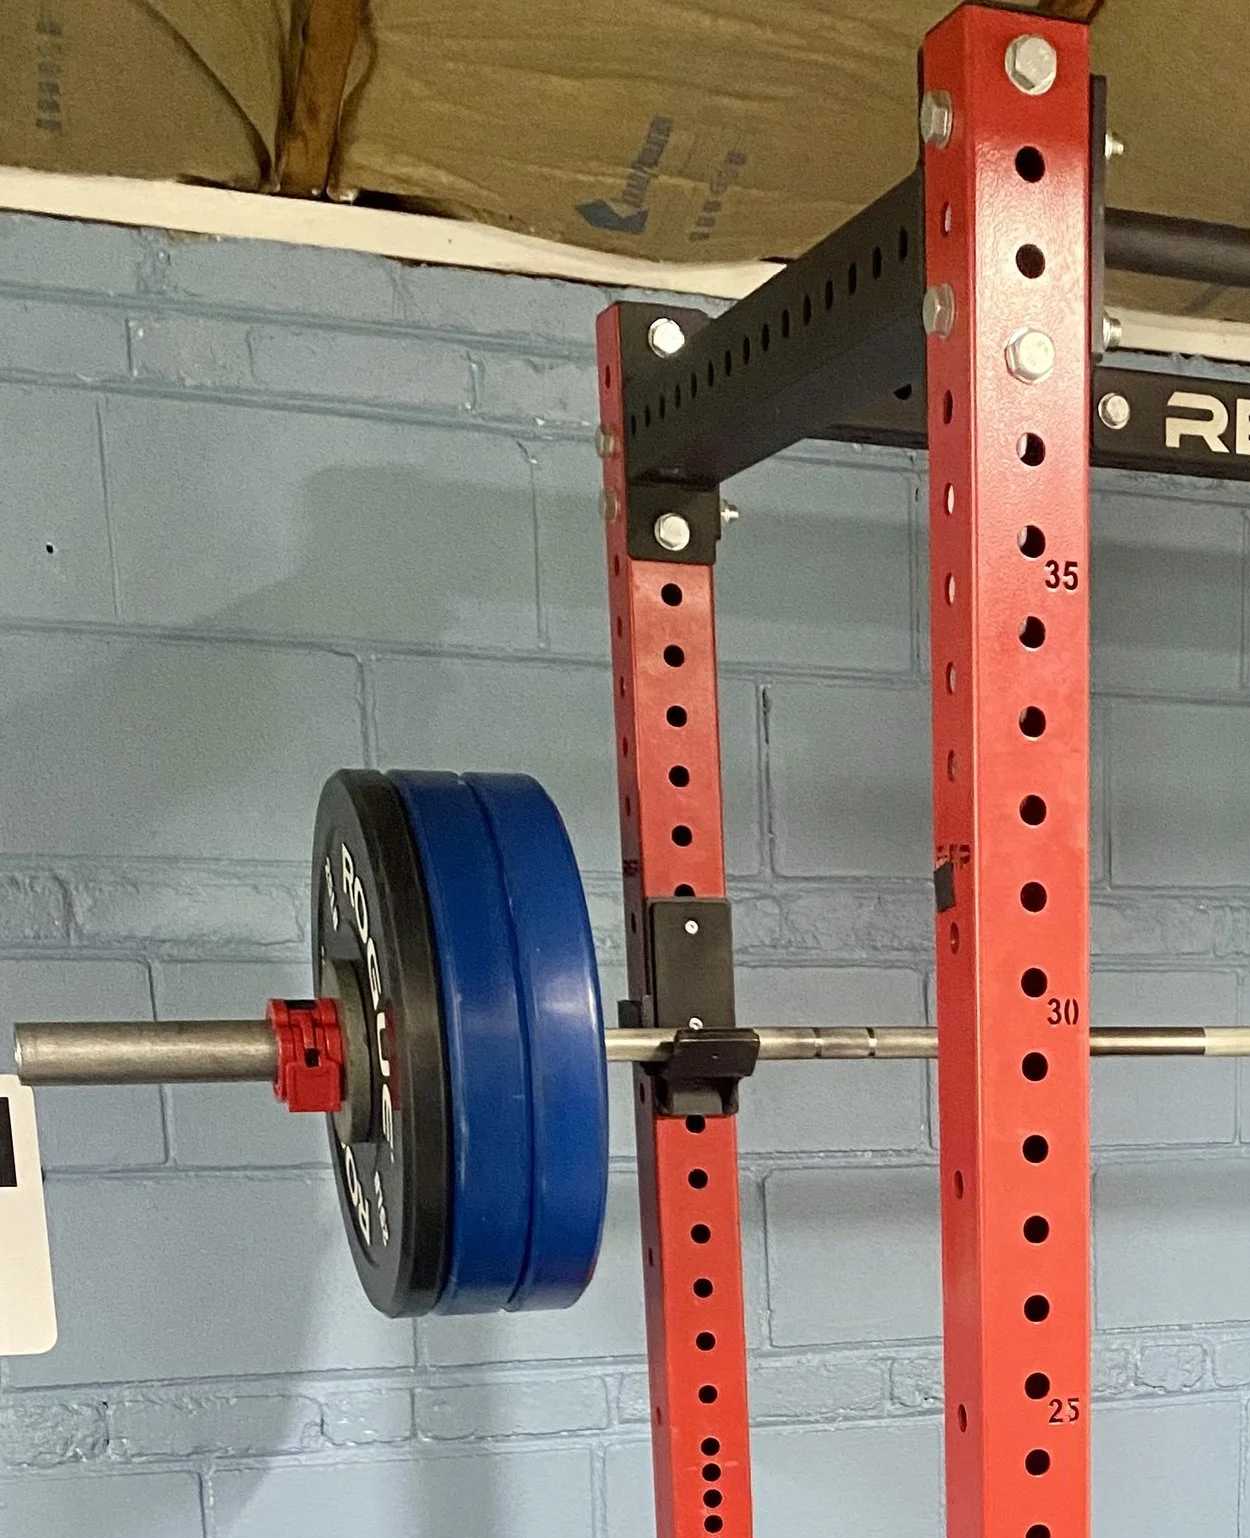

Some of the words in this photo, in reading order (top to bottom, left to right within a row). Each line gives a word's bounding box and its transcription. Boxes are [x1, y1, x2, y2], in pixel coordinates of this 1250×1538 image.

[1044, 559, 1079, 591] 35
[342, 842, 395, 1151] ROGUE
[1046, 998, 1079, 1025] 30
[1048, 1398, 1080, 1424] 25
